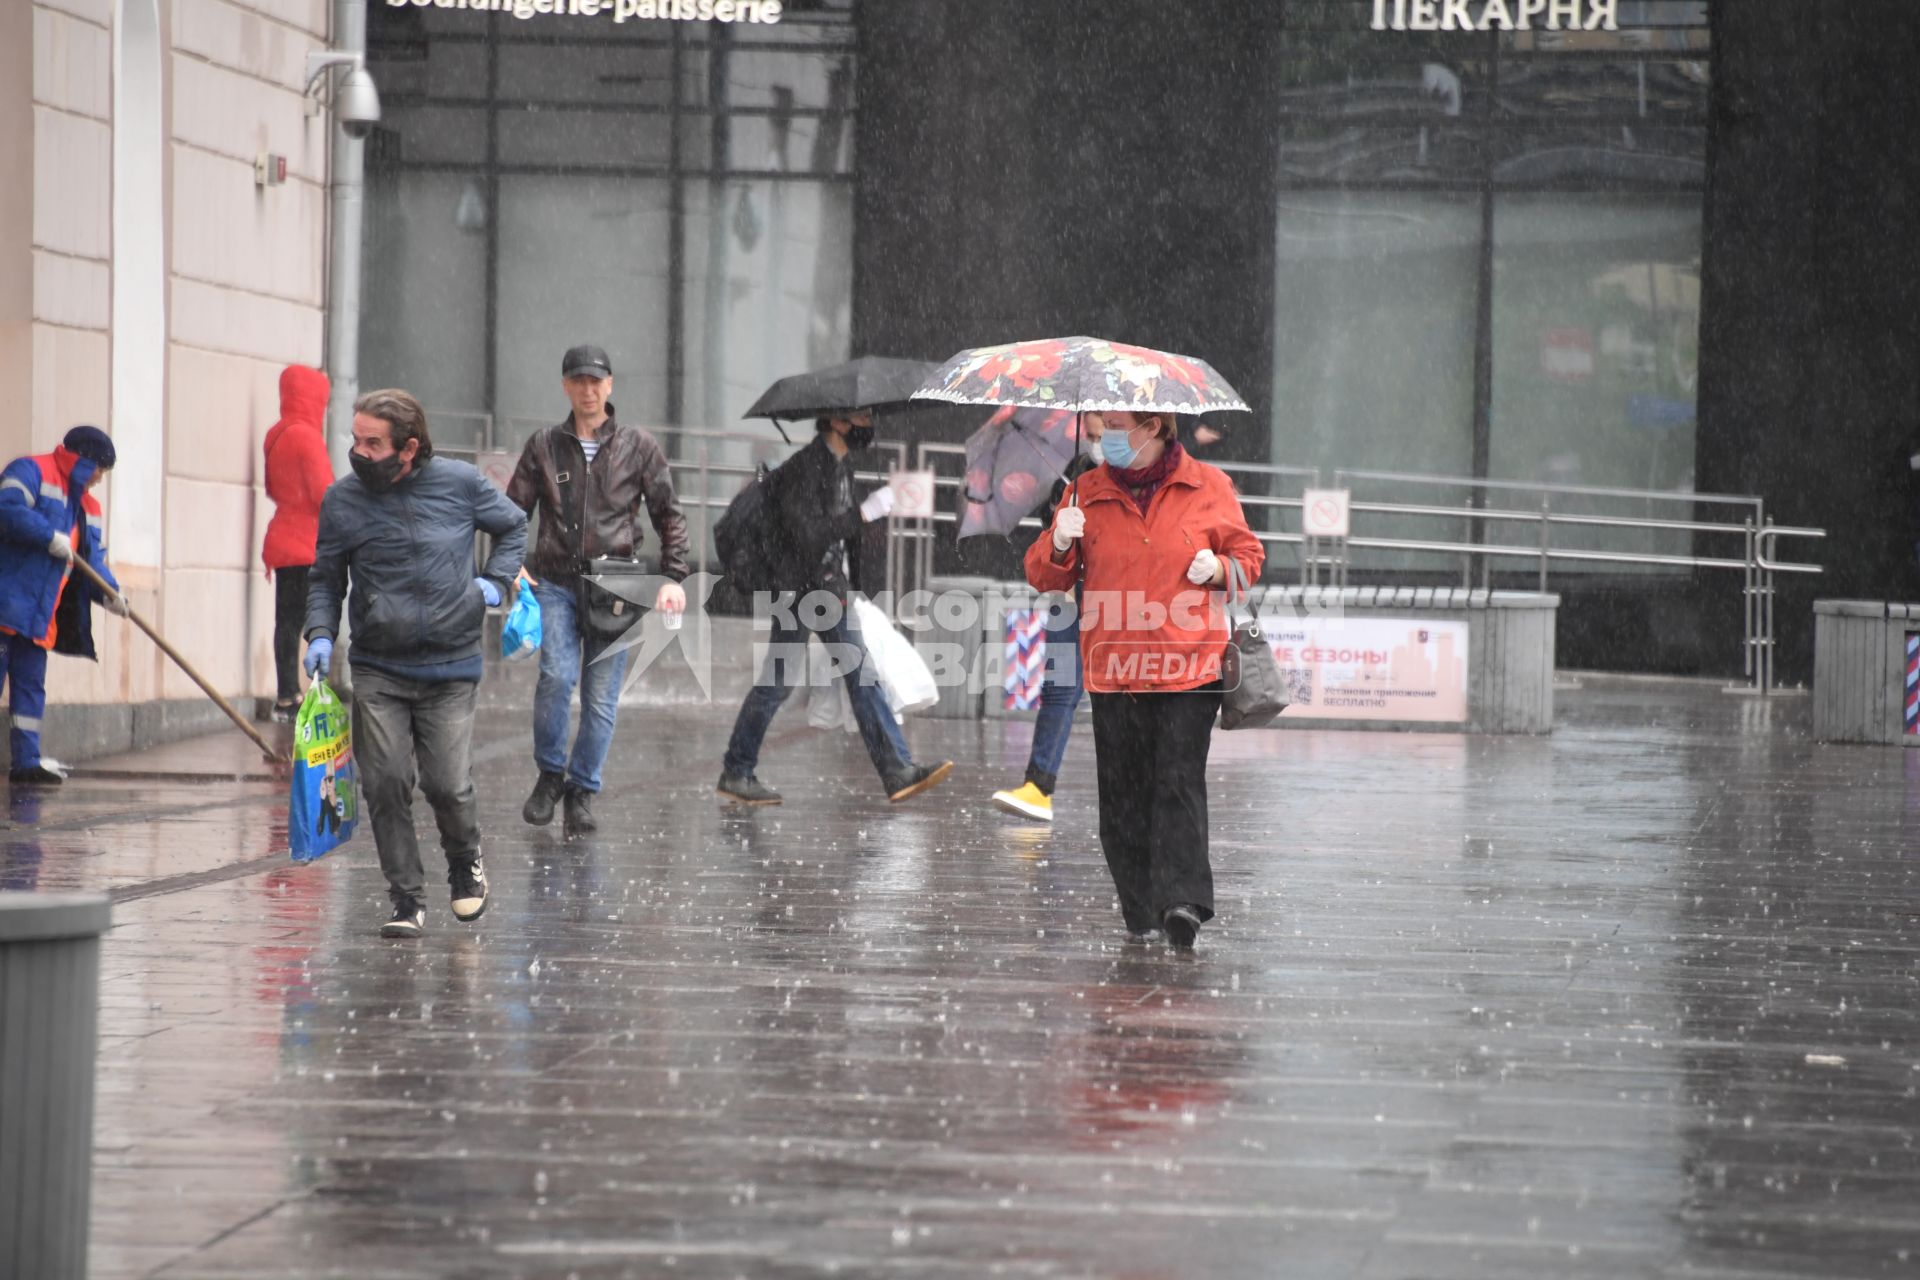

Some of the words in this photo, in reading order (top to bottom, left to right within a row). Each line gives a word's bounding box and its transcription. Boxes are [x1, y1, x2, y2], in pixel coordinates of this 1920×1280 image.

[1370, 0, 1618, 30] ПЕКАРНЯ
[1300, 648, 1388, 665] СЕЗОНЫ
[1324, 686, 1371, 697] Установи
[1374, 687, 1437, 699] приложение
[1324, 697, 1386, 708] БЕСПЛАТНО
